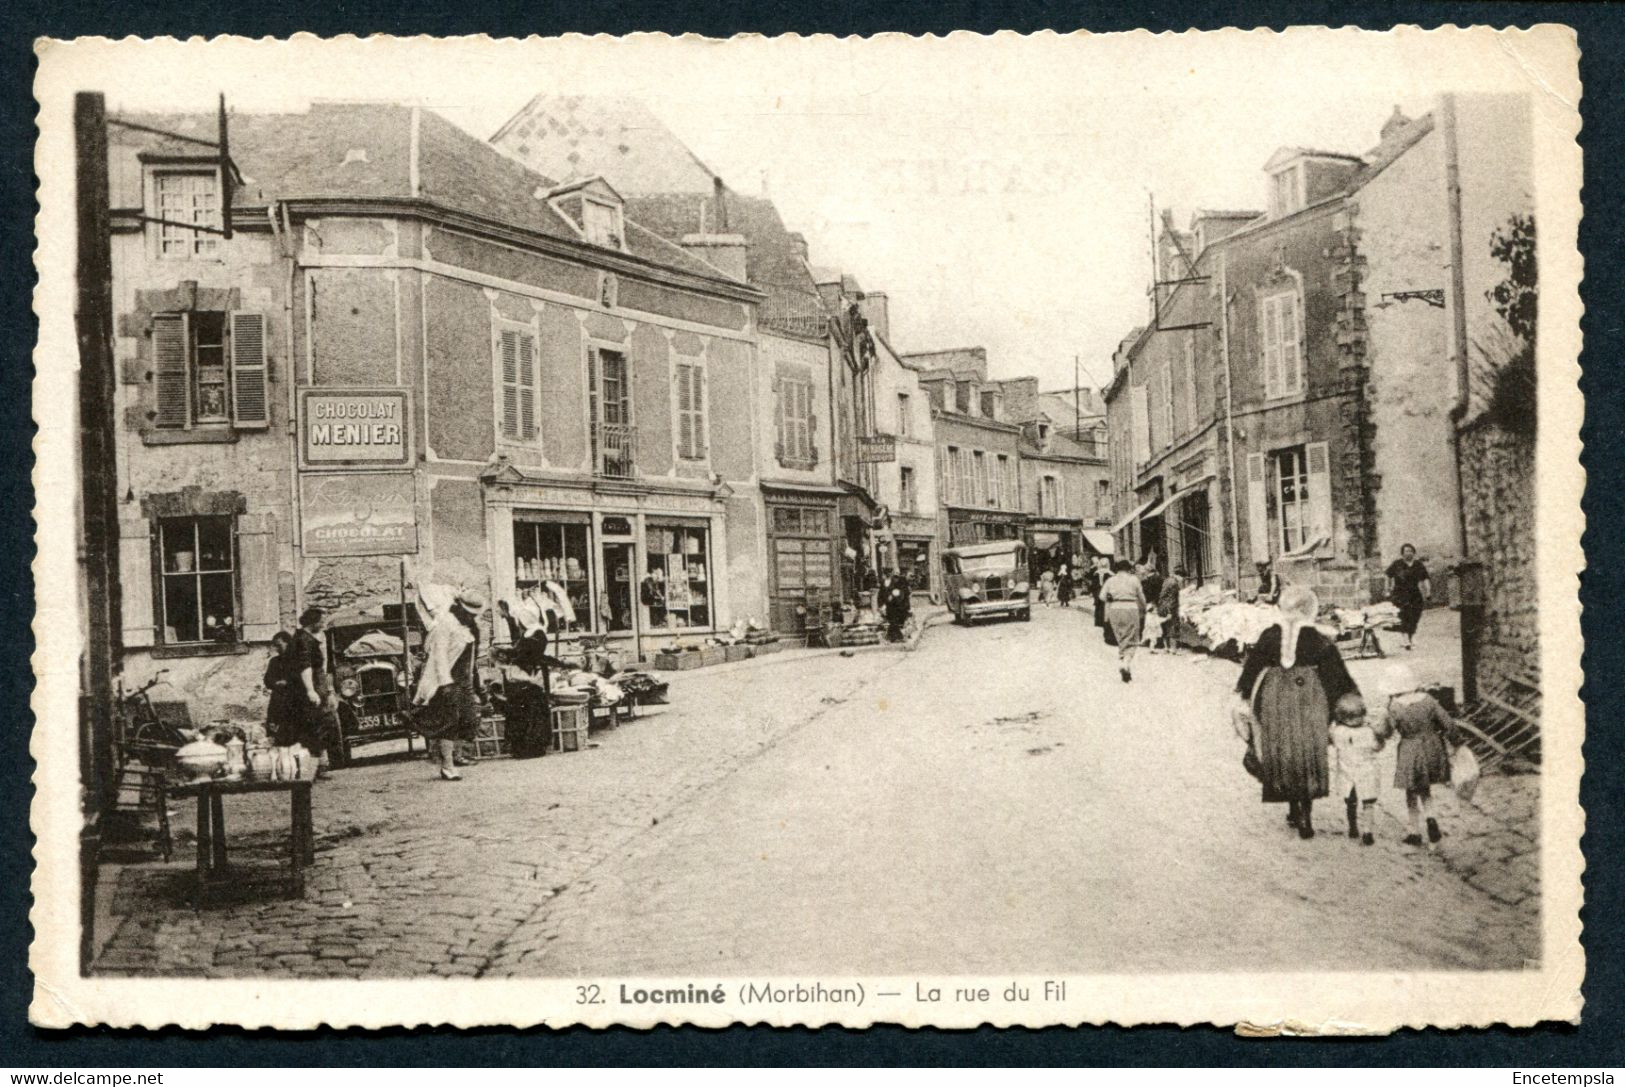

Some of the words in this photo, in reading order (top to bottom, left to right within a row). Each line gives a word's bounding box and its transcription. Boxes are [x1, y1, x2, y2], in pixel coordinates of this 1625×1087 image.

[315, 402, 396, 419] CHOCOLAT
[312, 424, 400, 446] MENIER
[315, 526, 404, 539] CHOCOLAT
